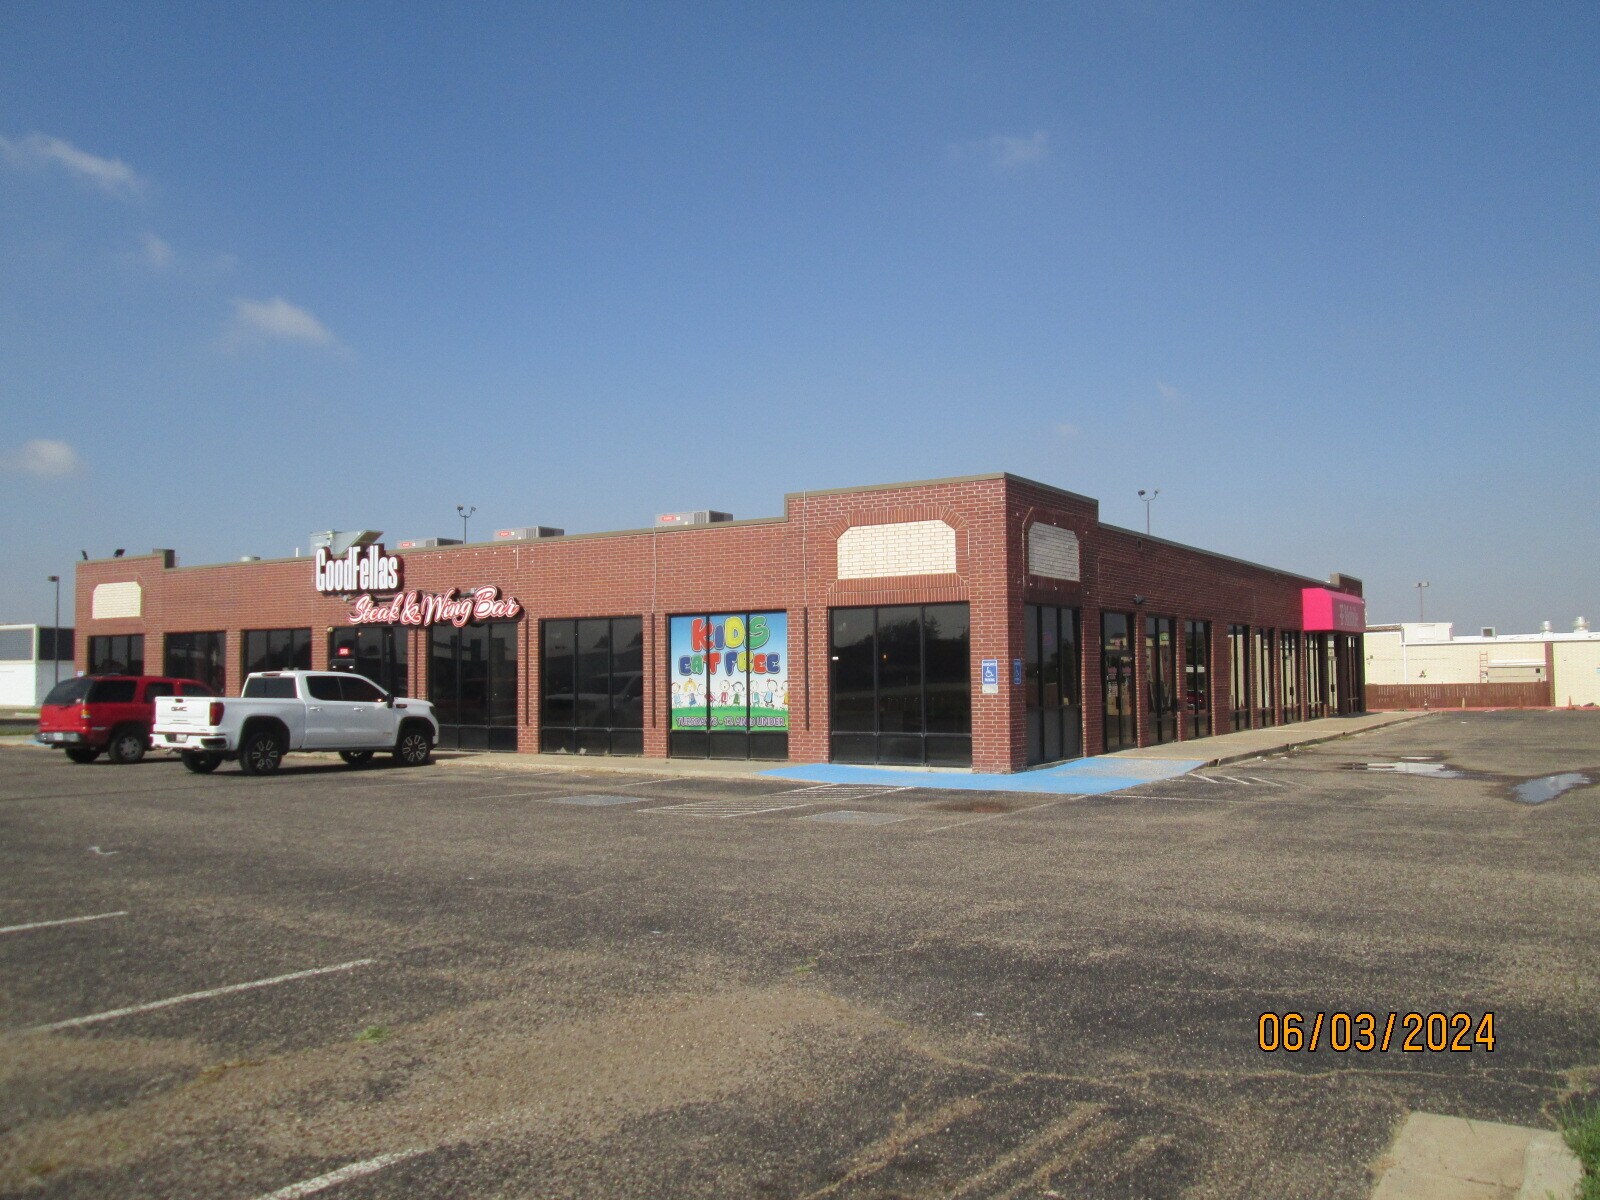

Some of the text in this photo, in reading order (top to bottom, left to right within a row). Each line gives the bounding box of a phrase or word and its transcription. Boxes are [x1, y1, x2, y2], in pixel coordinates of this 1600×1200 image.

[315, 546, 398, 591] GoodFellas
[349, 585, 520, 627] Steak & Wing Bar
[678, 650, 780, 676] EAT FREE
[756, 716, 786, 728] UNDER
